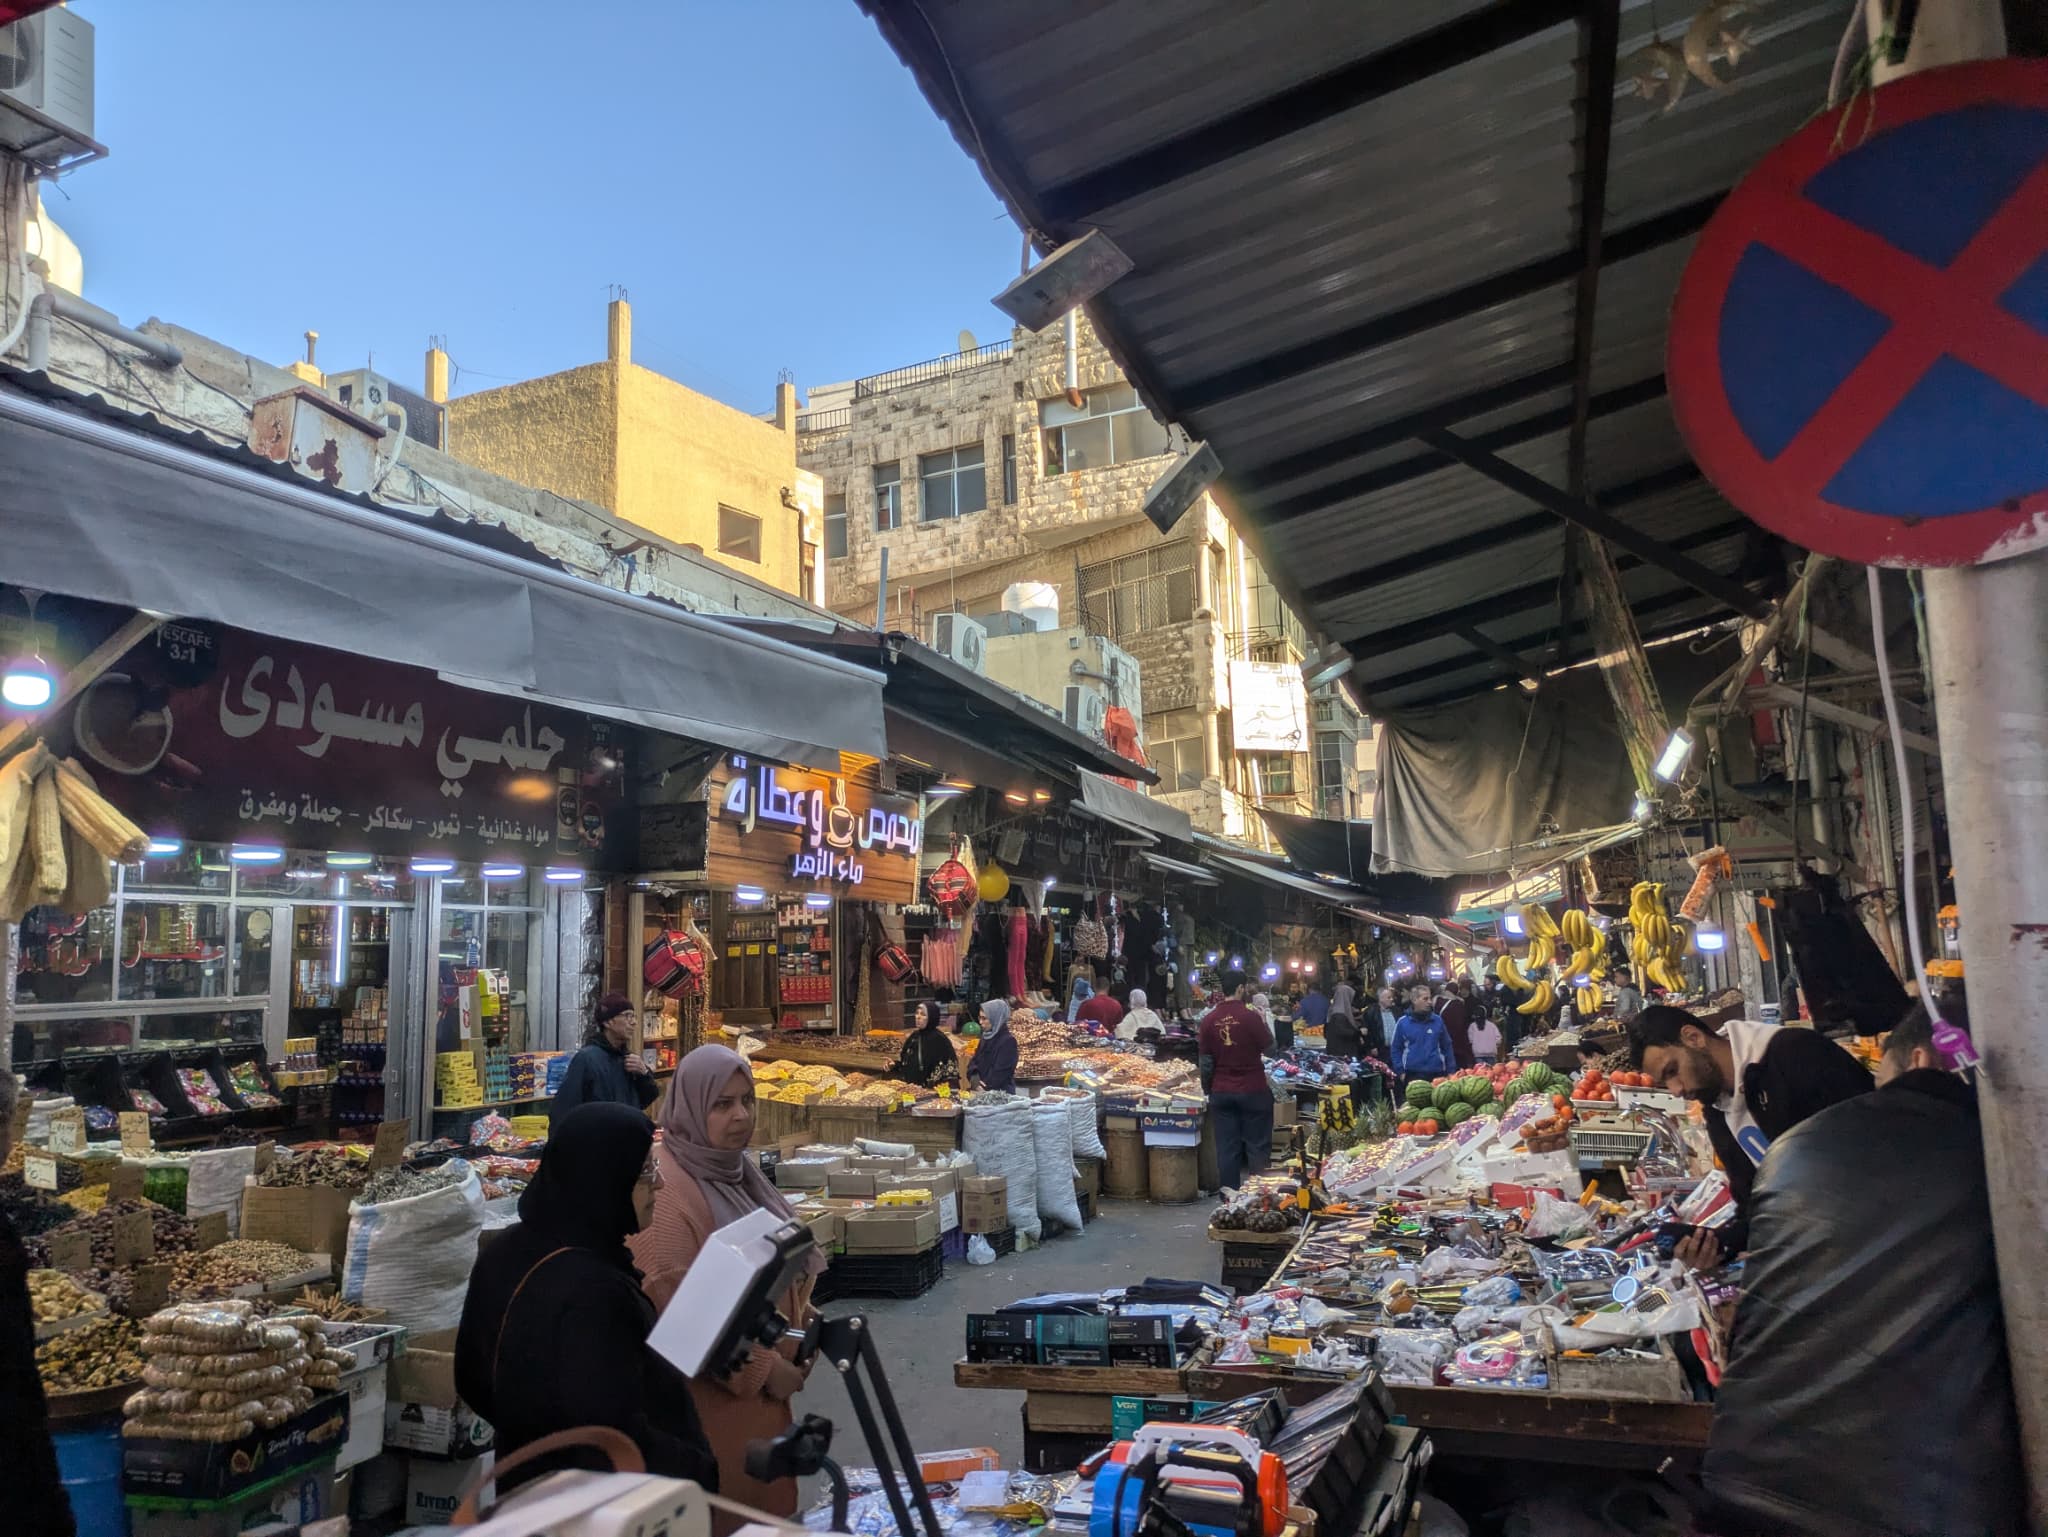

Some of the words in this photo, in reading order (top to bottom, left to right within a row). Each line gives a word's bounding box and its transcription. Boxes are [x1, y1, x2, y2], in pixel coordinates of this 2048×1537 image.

[436, 703, 565, 798] حلمي
[239, 789, 297, 825] ومفرق
[301, 793, 343, 828] جملة
[362, 805, 413, 832] سكاكر
[723, 754, 823, 848] وعطارة
[428, 813, 461, 840] تمور
[526, 823, 549, 848] مواد
[858, 807, 921, 854] محمص
[792, 848, 833, 880] الزهر
